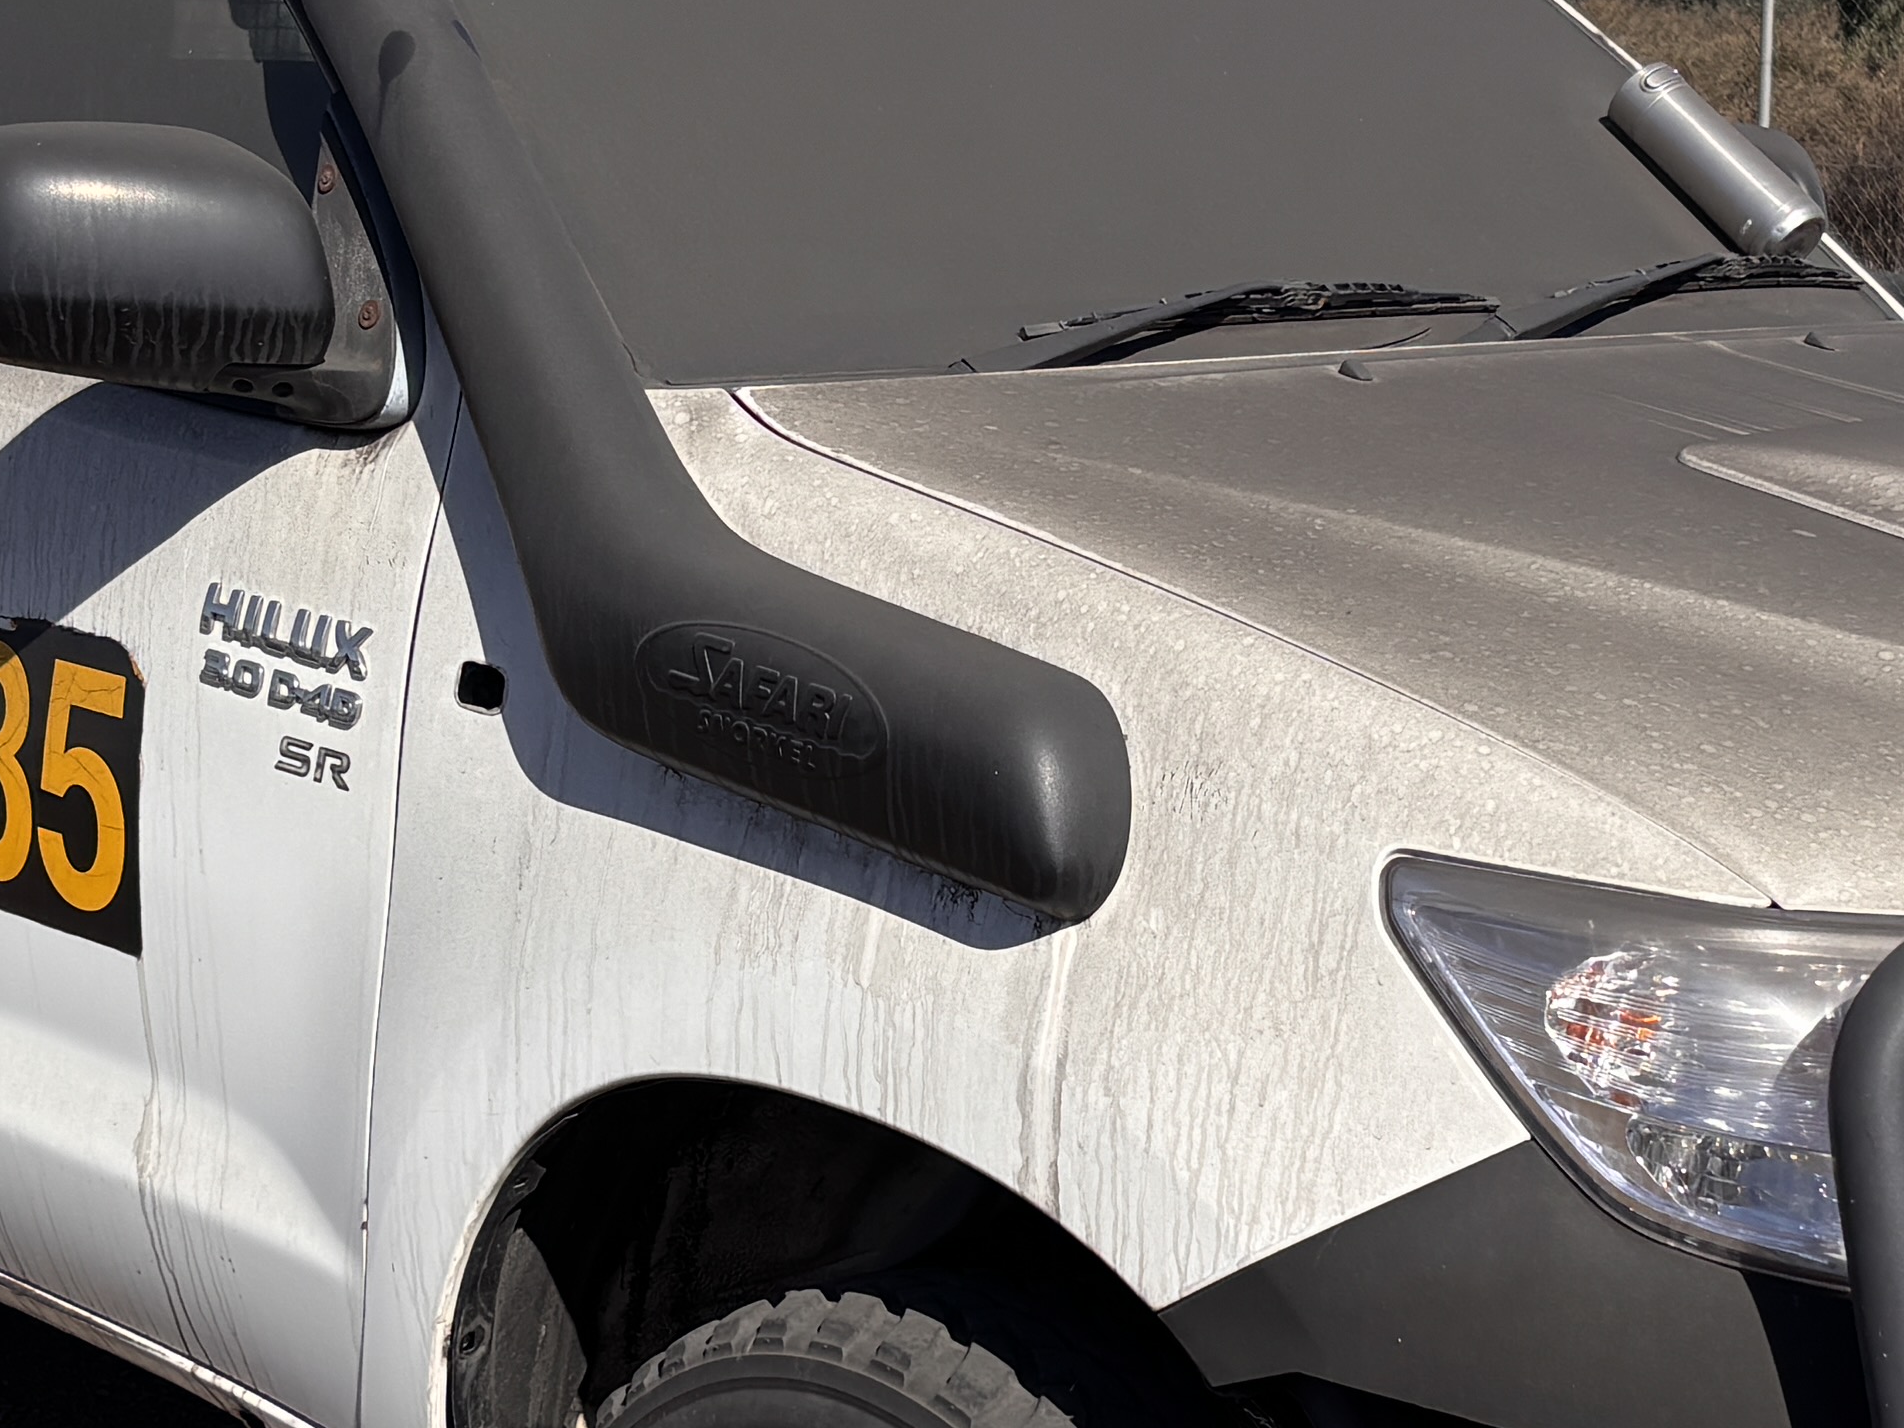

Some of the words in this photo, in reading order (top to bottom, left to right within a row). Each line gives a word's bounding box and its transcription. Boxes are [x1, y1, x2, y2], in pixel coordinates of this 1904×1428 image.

[199, 582, 374, 681] HILUX
[668, 631, 853, 742] SAFARI
[274, 735, 351, 792] SR
[697, 708, 817, 769] SNORKEL
